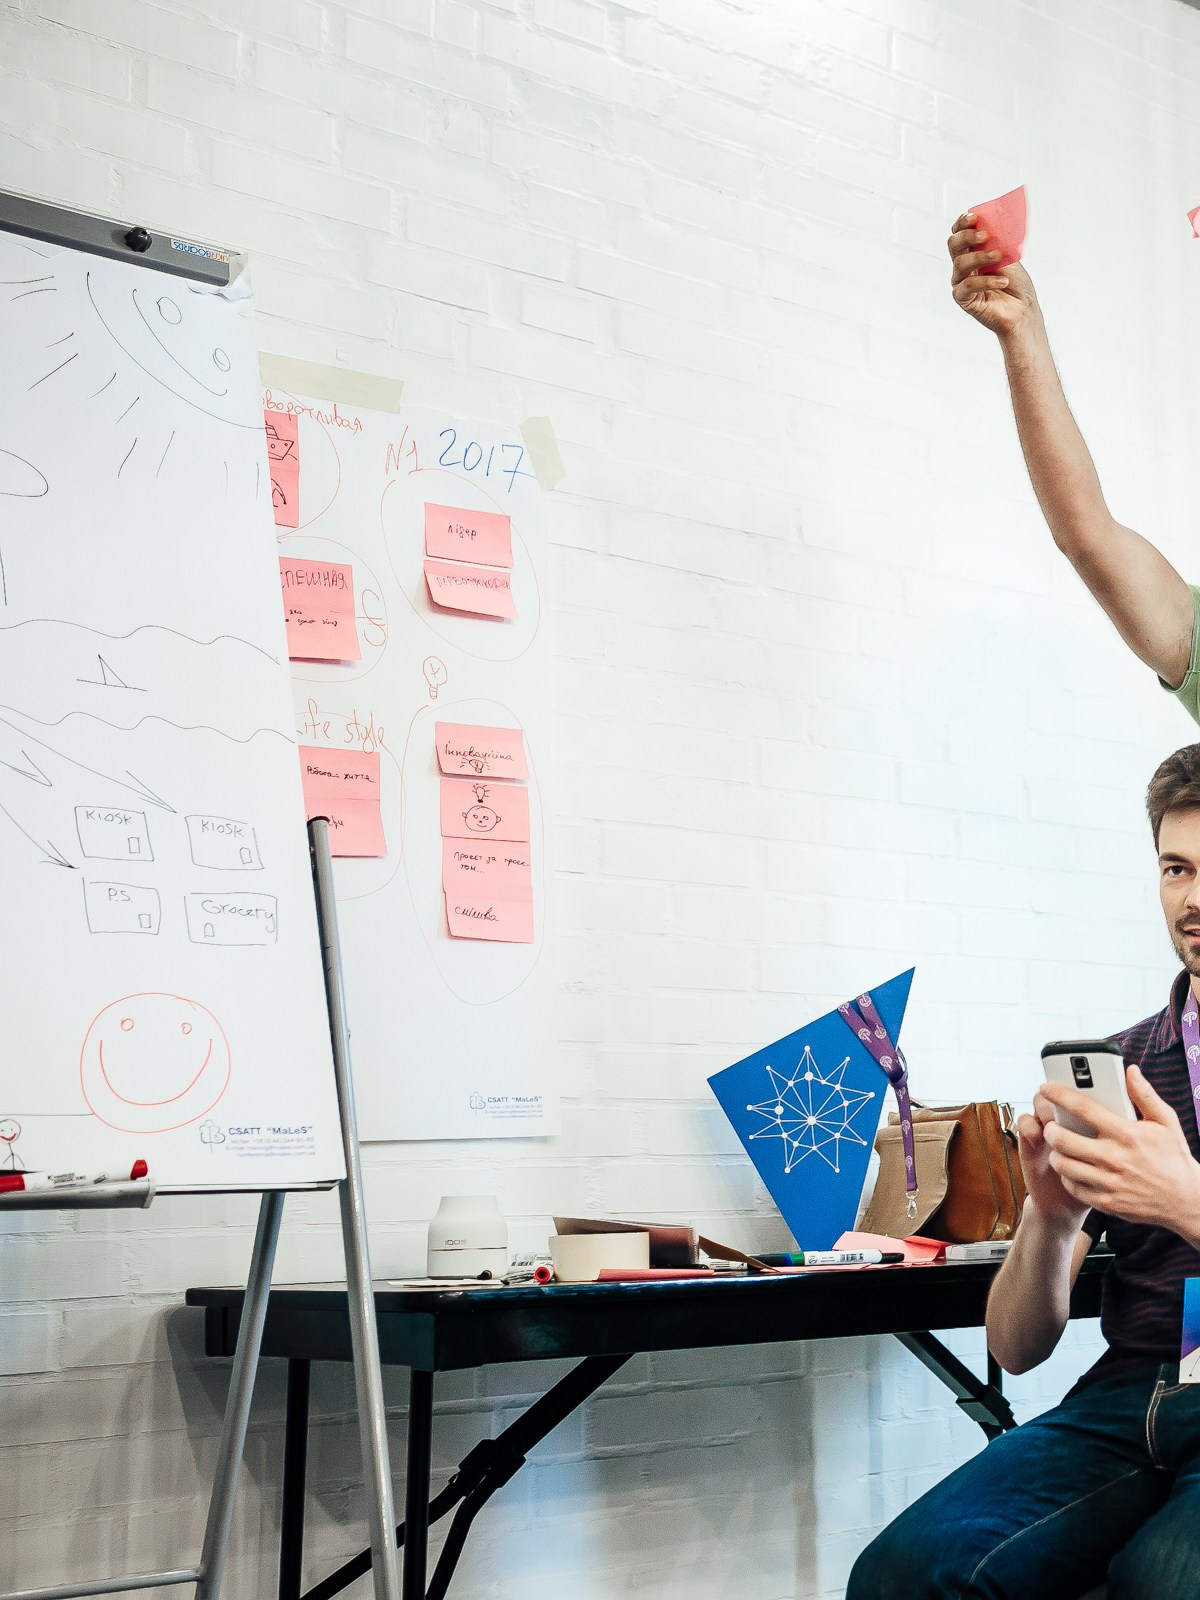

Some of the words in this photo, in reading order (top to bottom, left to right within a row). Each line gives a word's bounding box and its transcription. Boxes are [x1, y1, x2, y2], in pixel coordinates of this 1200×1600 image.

[262, 389, 363, 436] воротливая
[439, 428, 537, 493] 2017
[280, 569, 348, 591] ПЕШНАЯ
[201, 900, 275, 933] Grocery
[228, 1127, 261, 1135] CSATT
